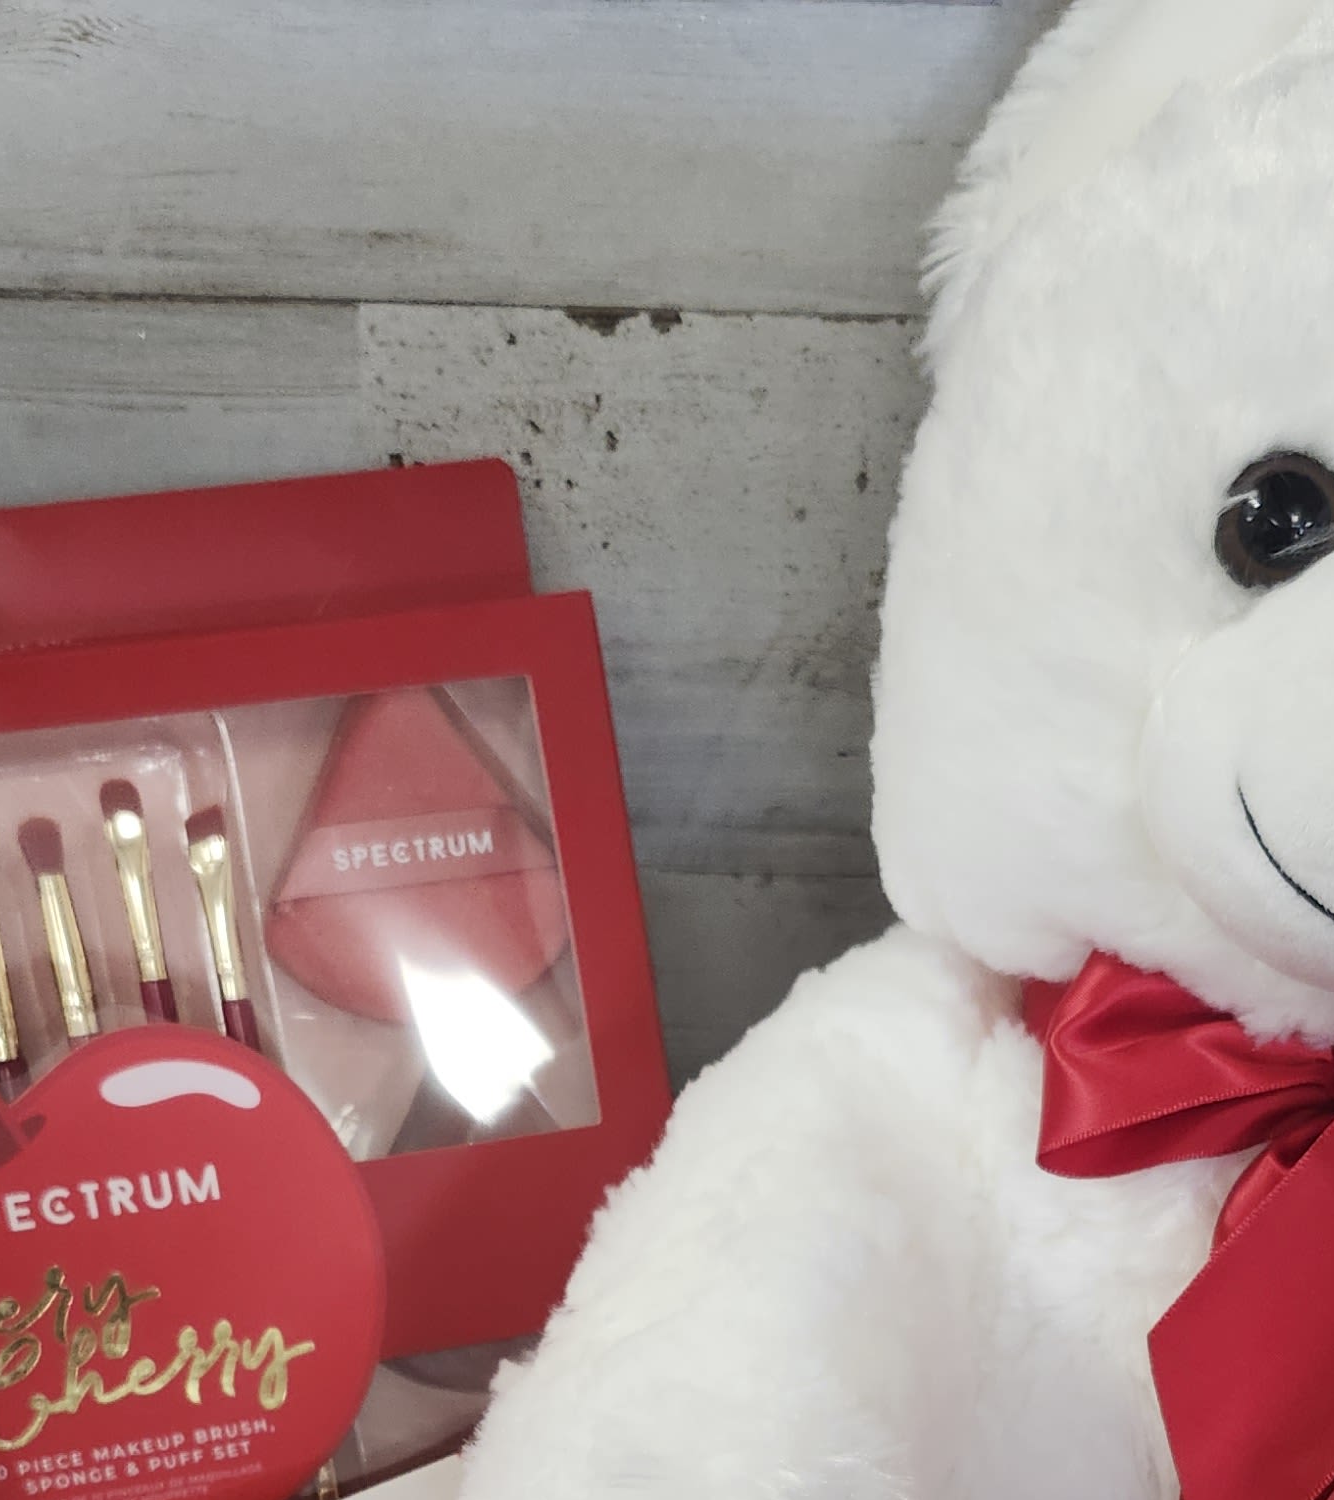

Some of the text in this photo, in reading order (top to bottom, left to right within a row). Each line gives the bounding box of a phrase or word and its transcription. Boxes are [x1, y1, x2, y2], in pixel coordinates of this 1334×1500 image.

[331, 828, 495, 872] SPECTRUM
[18, 1451, 84, 1476] PIECE
[92, 1432, 186, 1463] MAKEUP
[25, 1440, 252, 1496] SPONGE & PUFF SET
